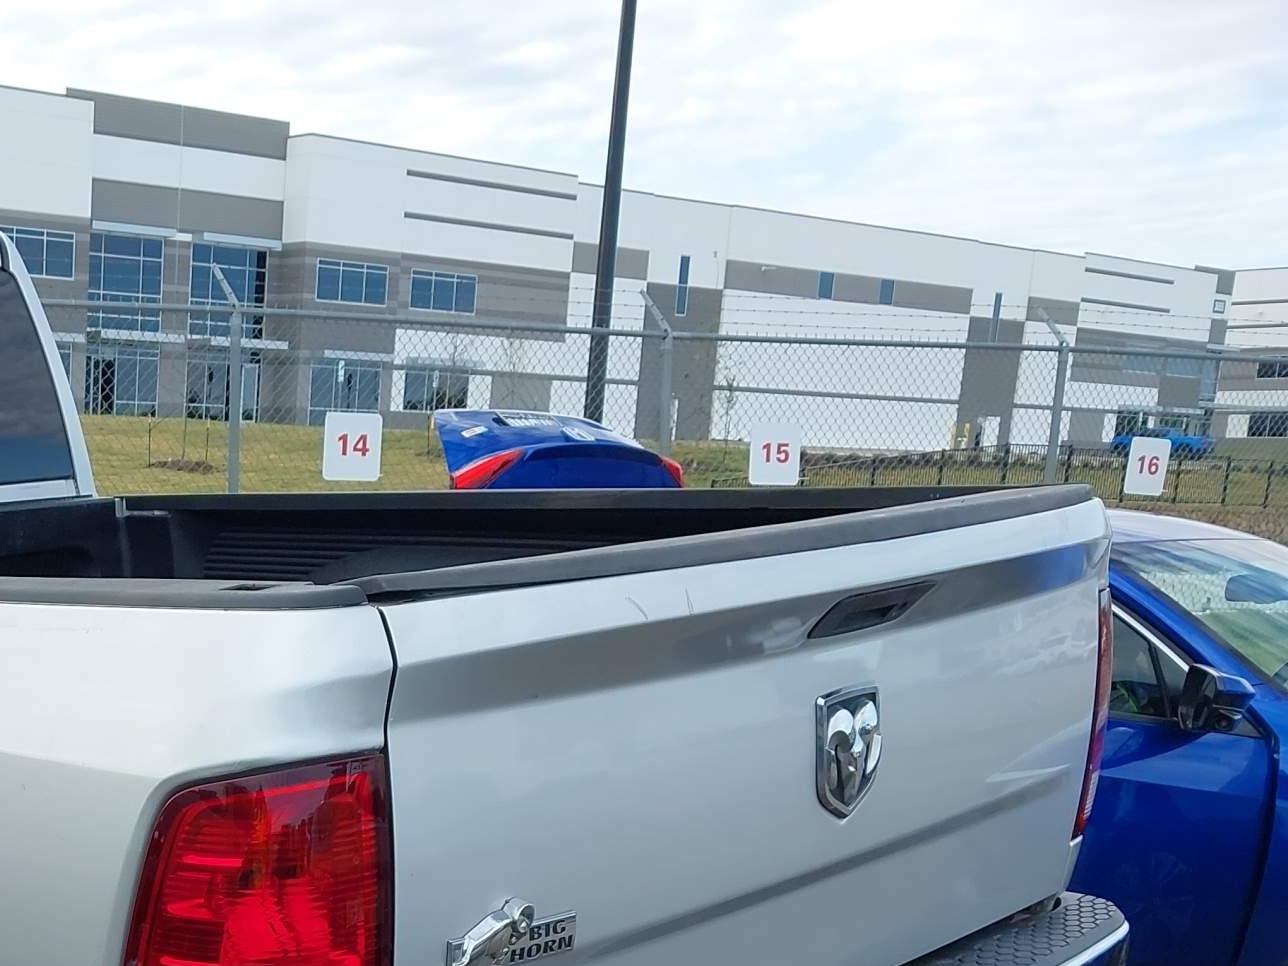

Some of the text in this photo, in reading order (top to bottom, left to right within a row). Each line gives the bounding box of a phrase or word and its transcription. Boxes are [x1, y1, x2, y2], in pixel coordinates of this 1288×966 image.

[337, 432, 370, 457] 14
[761, 442, 790, 464] 15
[1137, 455, 1160, 476] 16
[528, 919, 568, 942] BIG
[509, 935, 574, 963] HORN
